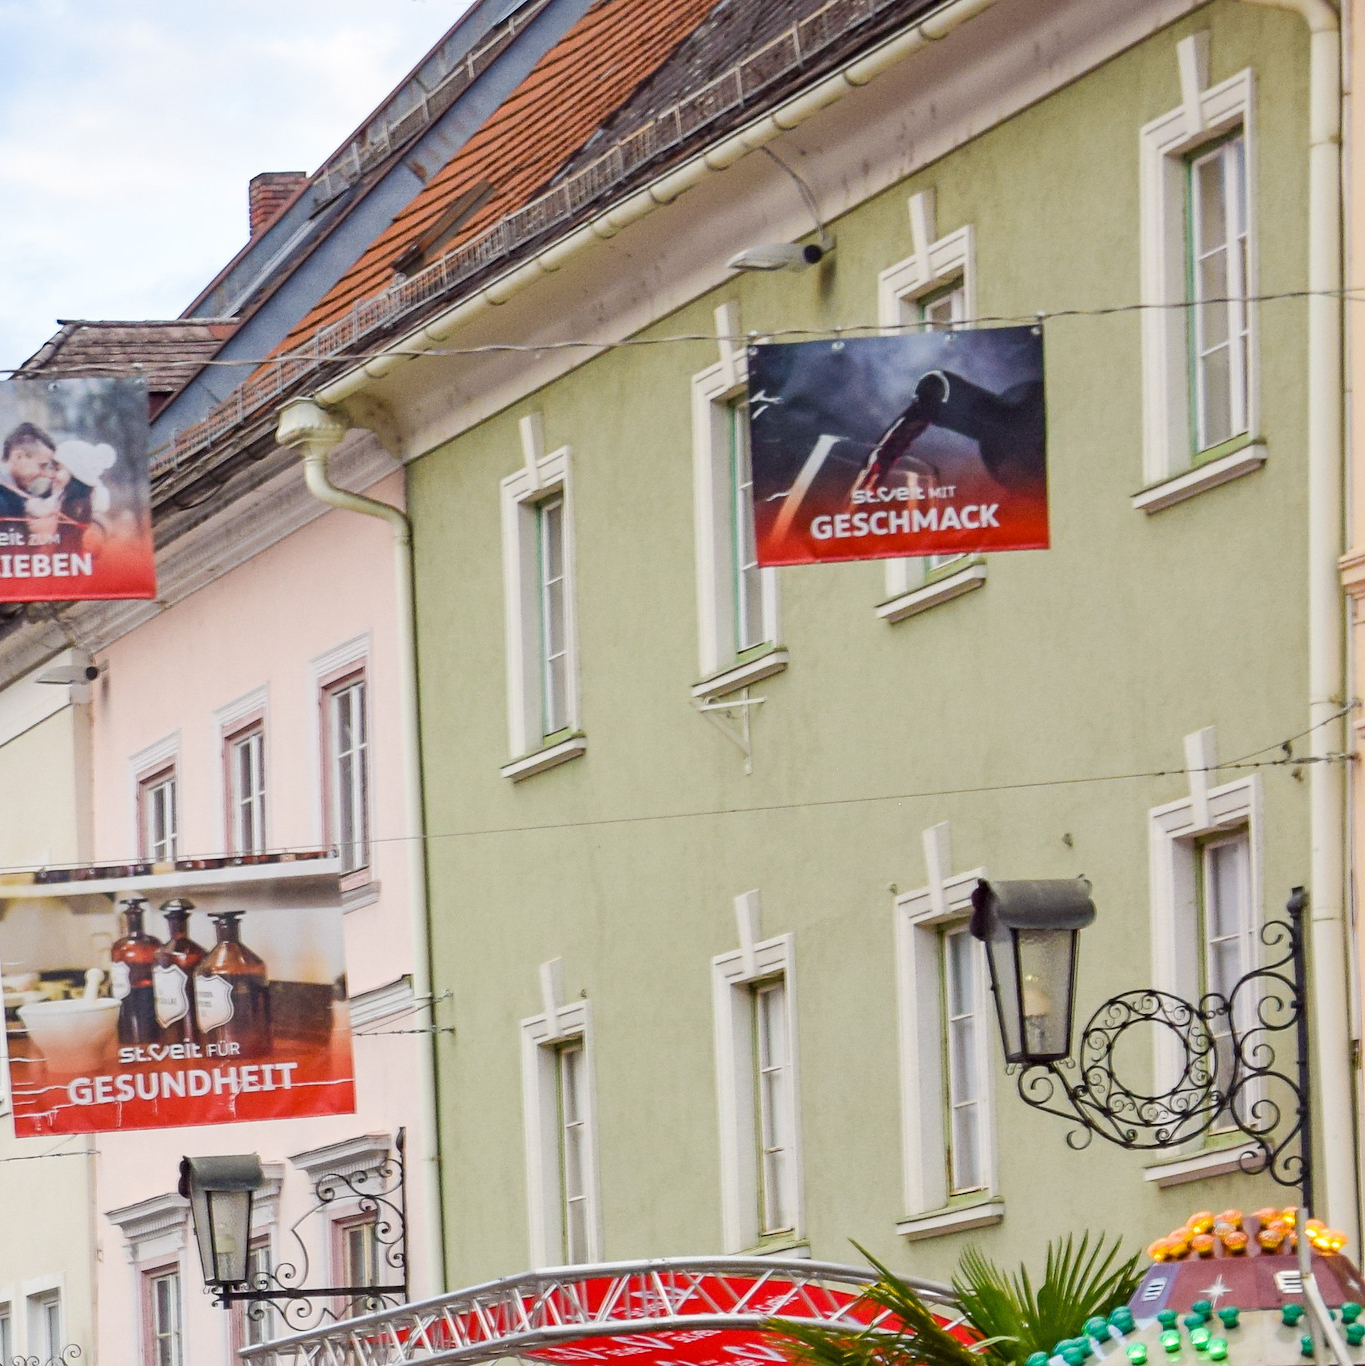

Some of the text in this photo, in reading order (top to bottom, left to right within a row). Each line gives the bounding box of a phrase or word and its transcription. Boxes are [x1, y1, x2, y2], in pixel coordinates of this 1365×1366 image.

[928, 485, 956, 499] MIT
[810, 504, 1000, 540] GESCHMACK
[28, 533, 60, 546] ZUM
[206, 1041, 240, 1057] FÜR
[68, 1061, 298, 1105] GESUNDHEIT
